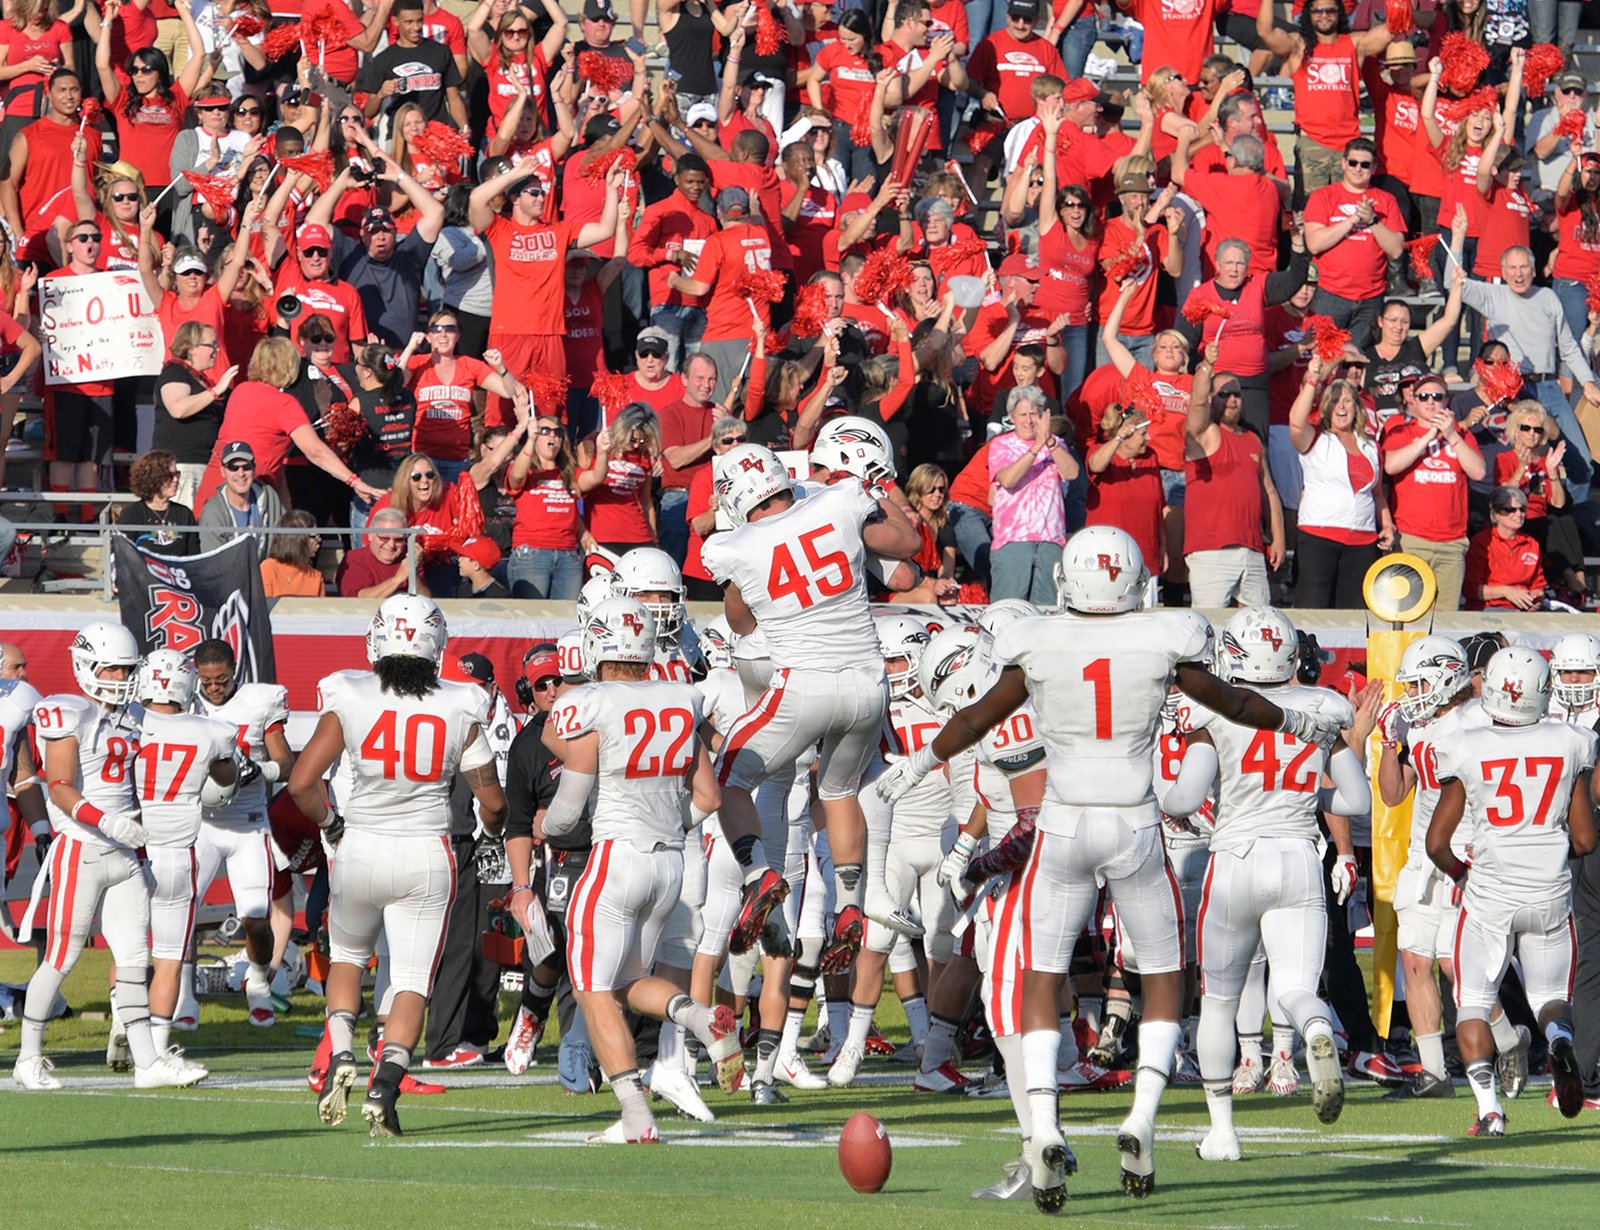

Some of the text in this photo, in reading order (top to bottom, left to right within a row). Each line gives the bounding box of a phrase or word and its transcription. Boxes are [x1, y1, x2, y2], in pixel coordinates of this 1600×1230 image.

[1415, 469, 1457, 484] RAIDERS
[768, 523, 853, 610] 45
[36, 706, 63, 728] 81
[553, 704, 581, 738] 22
[1082, 658, 1113, 740] 1
[138, 742, 198, 802] 17
[360, 709, 447, 782] 40
[624, 707, 694, 780] 22
[1160, 733, 1187, 781] 8
[1241, 728, 1318, 793] 42
[1481, 756, 1565, 827] 37
